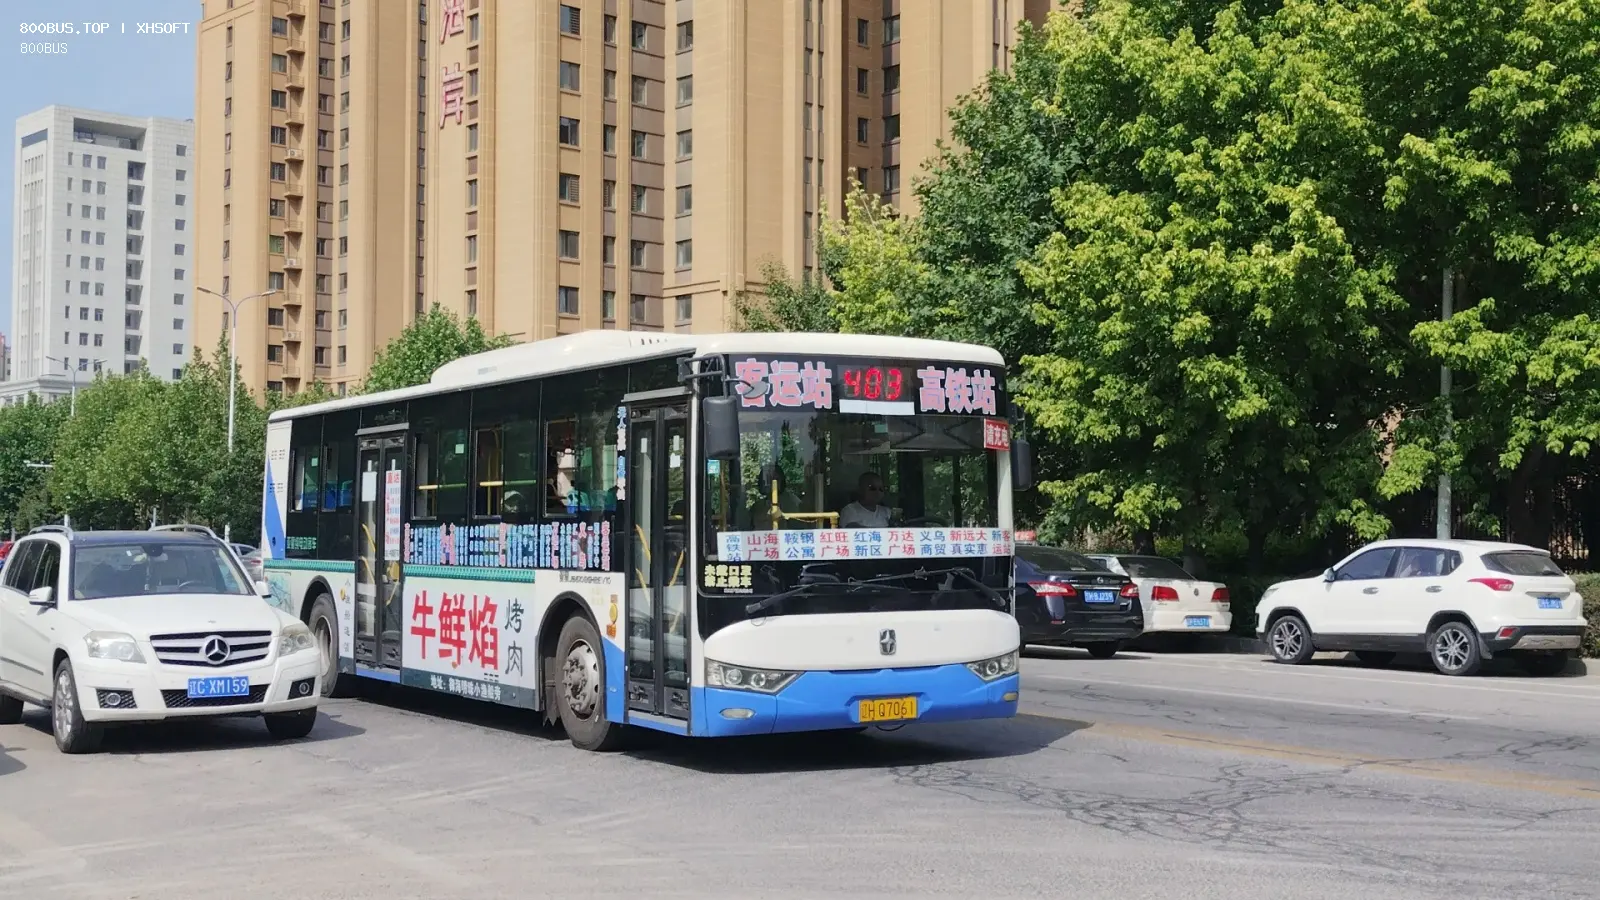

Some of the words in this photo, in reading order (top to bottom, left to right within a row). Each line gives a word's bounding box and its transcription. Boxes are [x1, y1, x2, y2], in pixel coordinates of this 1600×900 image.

[735, 358, 833, 409] 客运站
[916, 366, 997, 415] 高铁站
[726, 534, 742, 561] 高铁站
[747, 532, 780, 546] 山海
[784, 531, 815, 545] 鞍钢
[820, 530, 849, 544] 红旺
[853, 530, 882, 543] 红海
[888, 530, 915, 542] 万达
[920, 530, 946, 542] 义乌
[949, 530, 987, 542] 新远大
[992, 530, 1011, 542] 新客
[748, 547, 781, 560] 广场
[786, 546, 816, 559] 公寓
[821, 545, 850, 557] 广场
[854, 544, 883, 557] 新区
[887, 544, 916, 556] 广场
[920, 544, 947, 556] 商贸
[950, 543, 988, 555] 真实惠
[411, 590, 499, 671] 牛鲜焰
[505, 597, 525, 678] 烤肉
